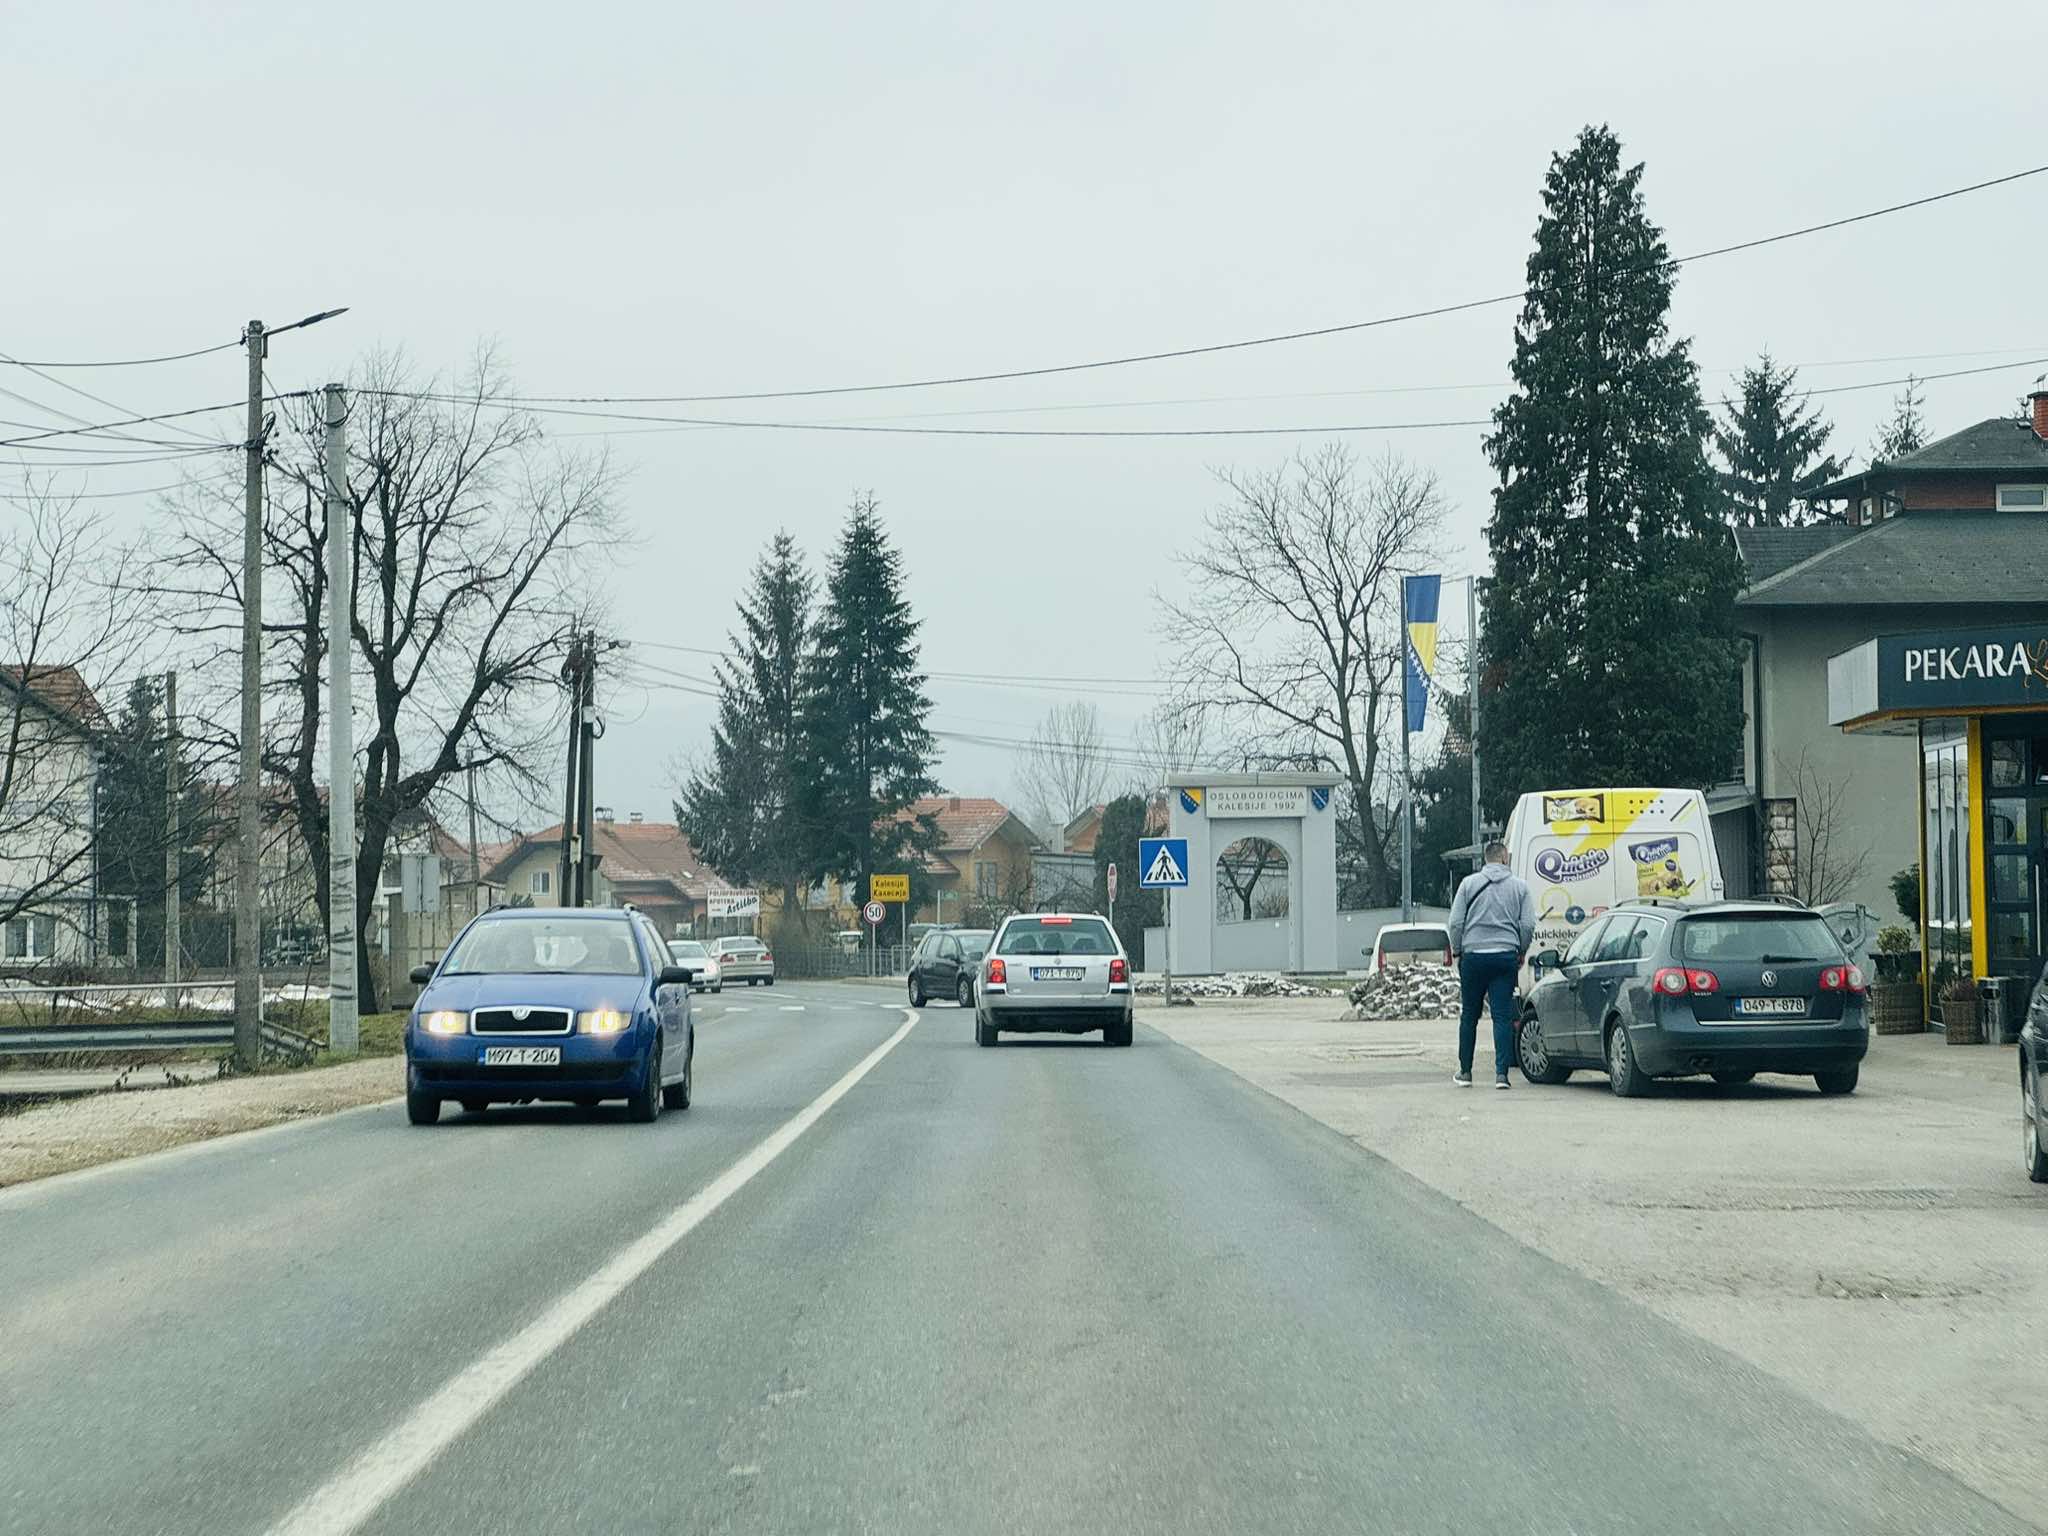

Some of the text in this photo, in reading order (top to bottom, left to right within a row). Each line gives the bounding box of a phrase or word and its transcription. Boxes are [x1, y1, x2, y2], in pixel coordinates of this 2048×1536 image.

[1905, 642, 2032, 682] PEKARA
[1217, 802, 1266, 811] KALESIJE
[1536, 848, 1608, 883] Quickie
[868, 906, 881, 918] 50
[1743, 1000, 1803, 1012] 049-T-878
[487, 1048, 558, 1064] M97-T-206
